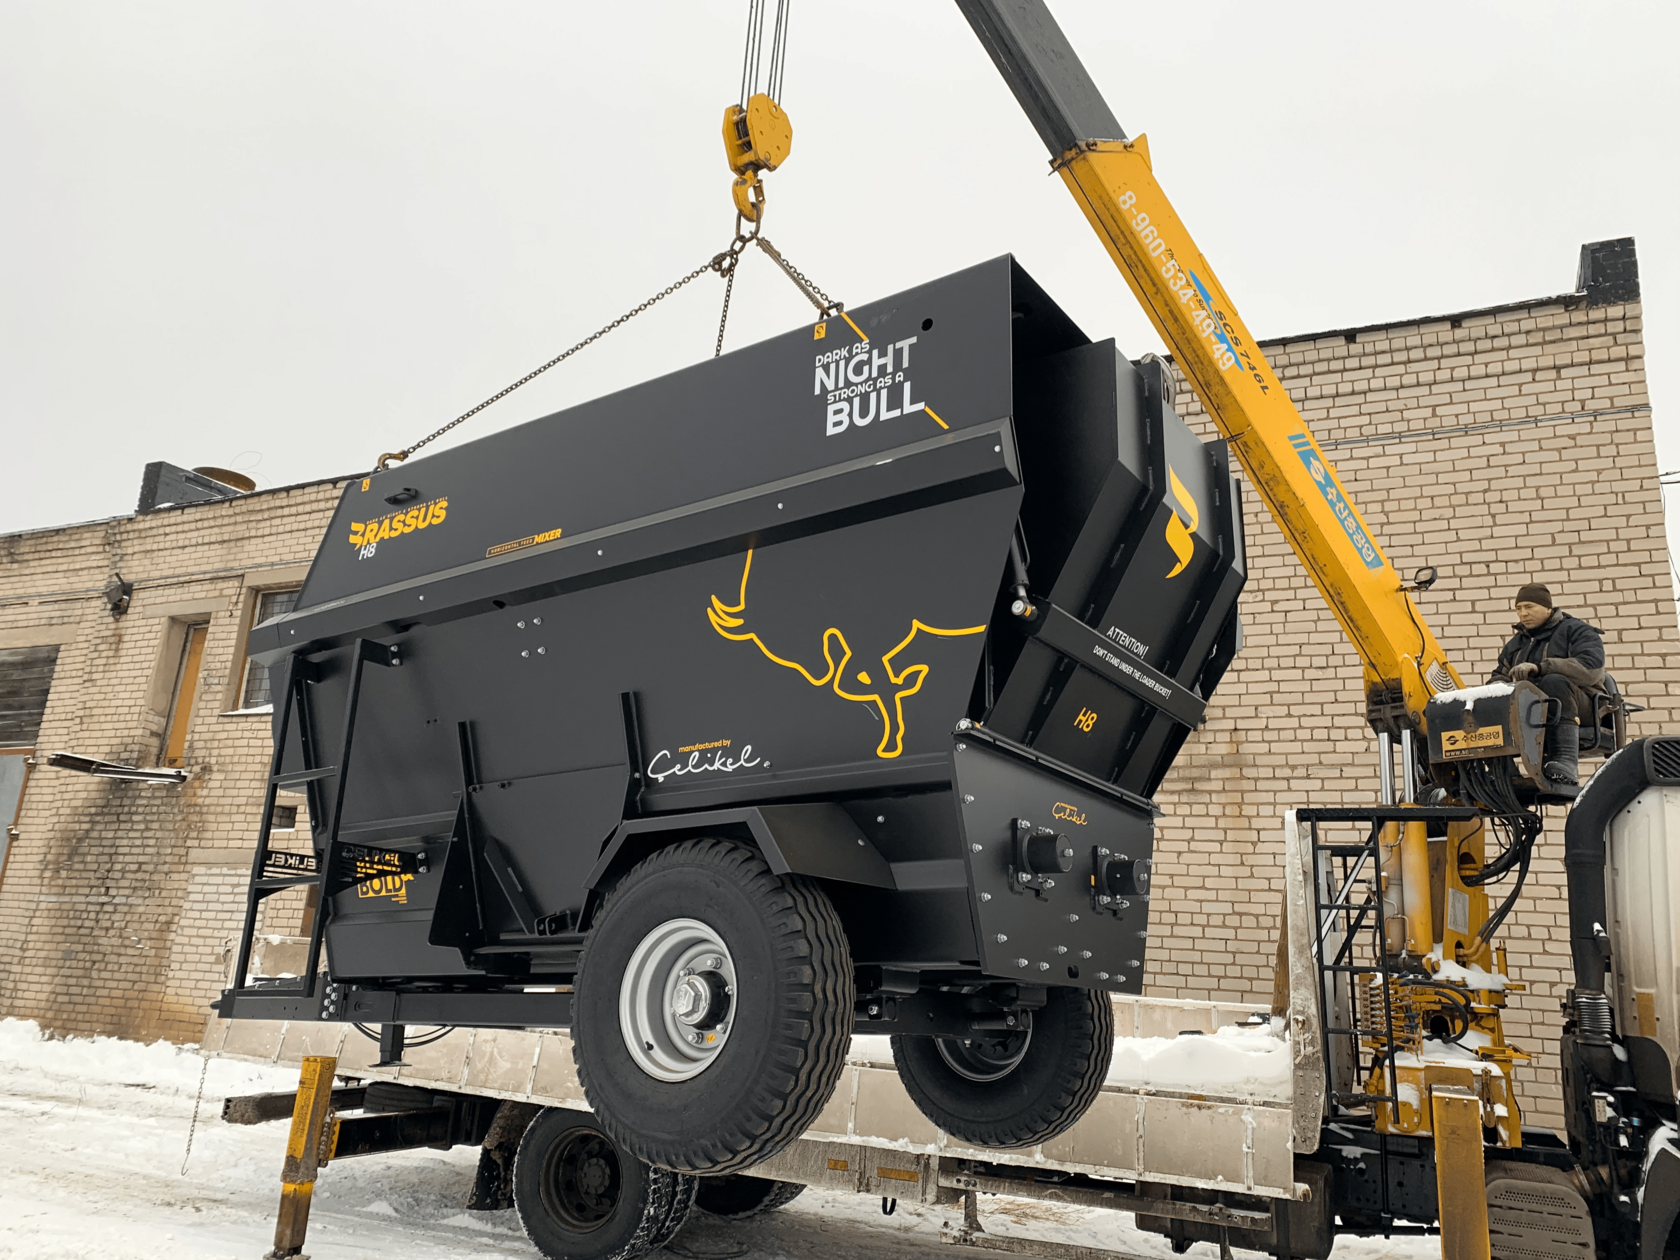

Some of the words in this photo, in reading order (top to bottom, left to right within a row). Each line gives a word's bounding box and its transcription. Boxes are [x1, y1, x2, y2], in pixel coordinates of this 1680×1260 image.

[1118, 190, 1236, 371] 8-960-534-49-49
[814, 335, 918, 396] NIGHT
[815, 345, 850, 367] DARK
[852, 340, 870, 356] AS
[1214, 310, 1242, 347] SCS
[1239, 350, 1269, 396] 746L
[827, 380, 874, 404] STRONG
[876, 374, 893, 390] AS
[895, 371, 904, 384] A
[825, 380, 926, 437] BULL
[534, 528, 562, 545] MIXER
[1326, 486, 1375, 563] 수산중공업
[359, 542, 377, 561] H8
[1106, 625, 1149, 660] ATTENTION!
[1105, 652, 1121, 667] STAND
[1118, 660, 1134, 676] UNDER
[1132, 668, 1142, 680] THE
[1139, 673, 1156, 689] LOADER
[1073, 706, 1098, 732] H8
[678, 739, 722, 753] manufactured
[722, 739, 731, 748] by
[360, 875, 404, 896] BOLD
